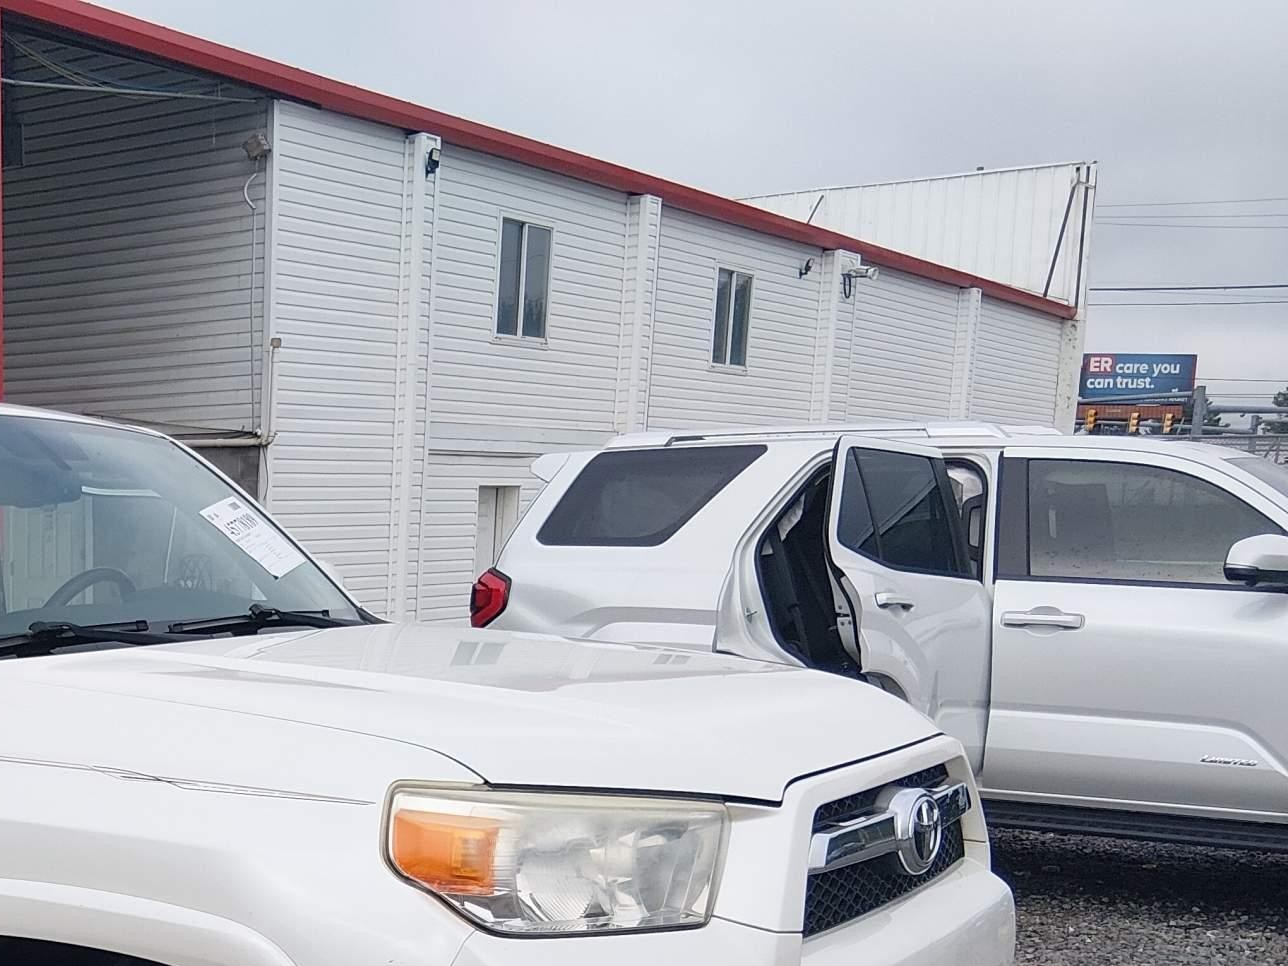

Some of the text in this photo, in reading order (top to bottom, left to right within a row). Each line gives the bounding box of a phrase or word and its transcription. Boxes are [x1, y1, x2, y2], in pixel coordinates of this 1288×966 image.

[1089, 357, 1181, 377] ER care you
[1086, 376, 1155, 389] can trust.
